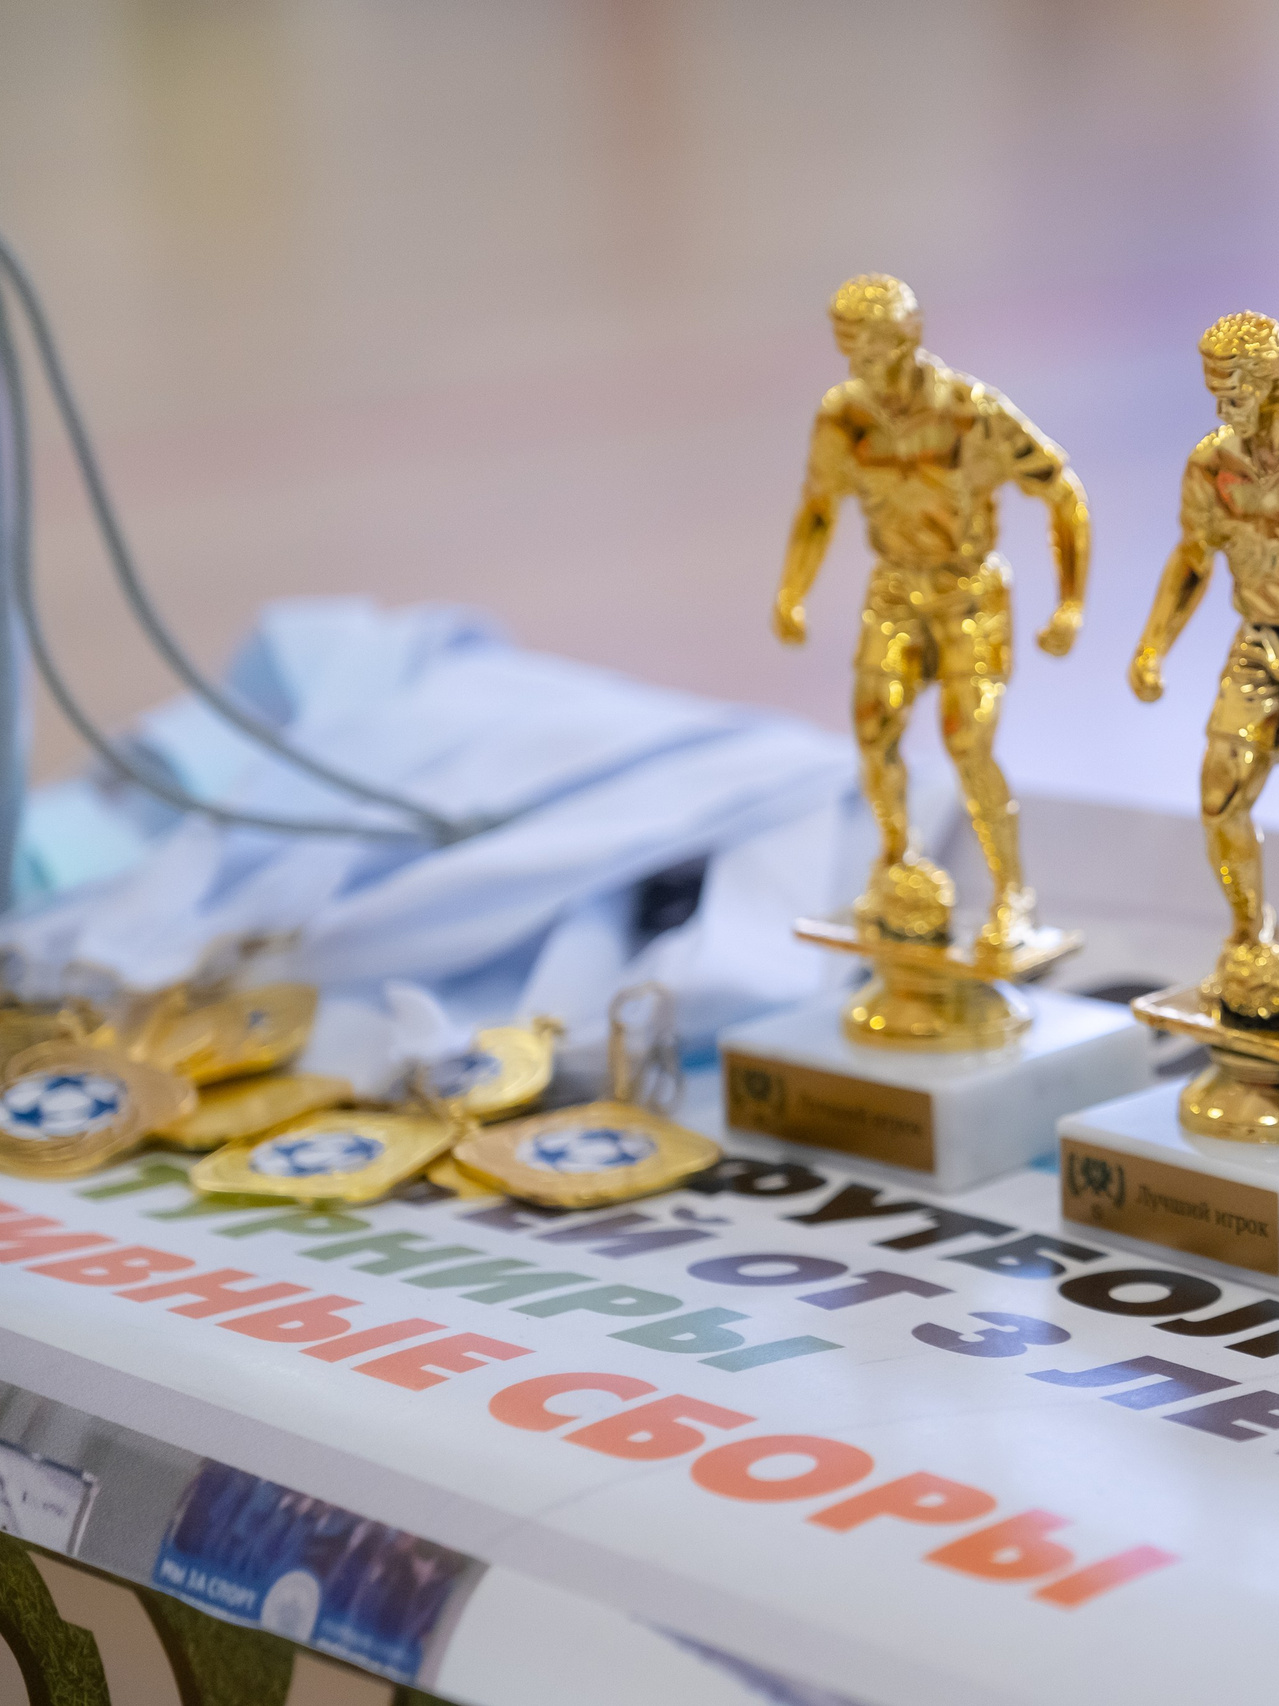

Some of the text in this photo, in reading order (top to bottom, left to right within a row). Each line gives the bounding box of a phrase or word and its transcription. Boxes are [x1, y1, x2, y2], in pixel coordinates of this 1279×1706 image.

[1137, 1185, 1268, 1237] Лучший игрок
[686, 1252, 957, 1312] ОТ
[911, 1310, 1072, 1359] 3
[0, 1200, 1182, 1612] ИВНЫЕ СБОРЫ
